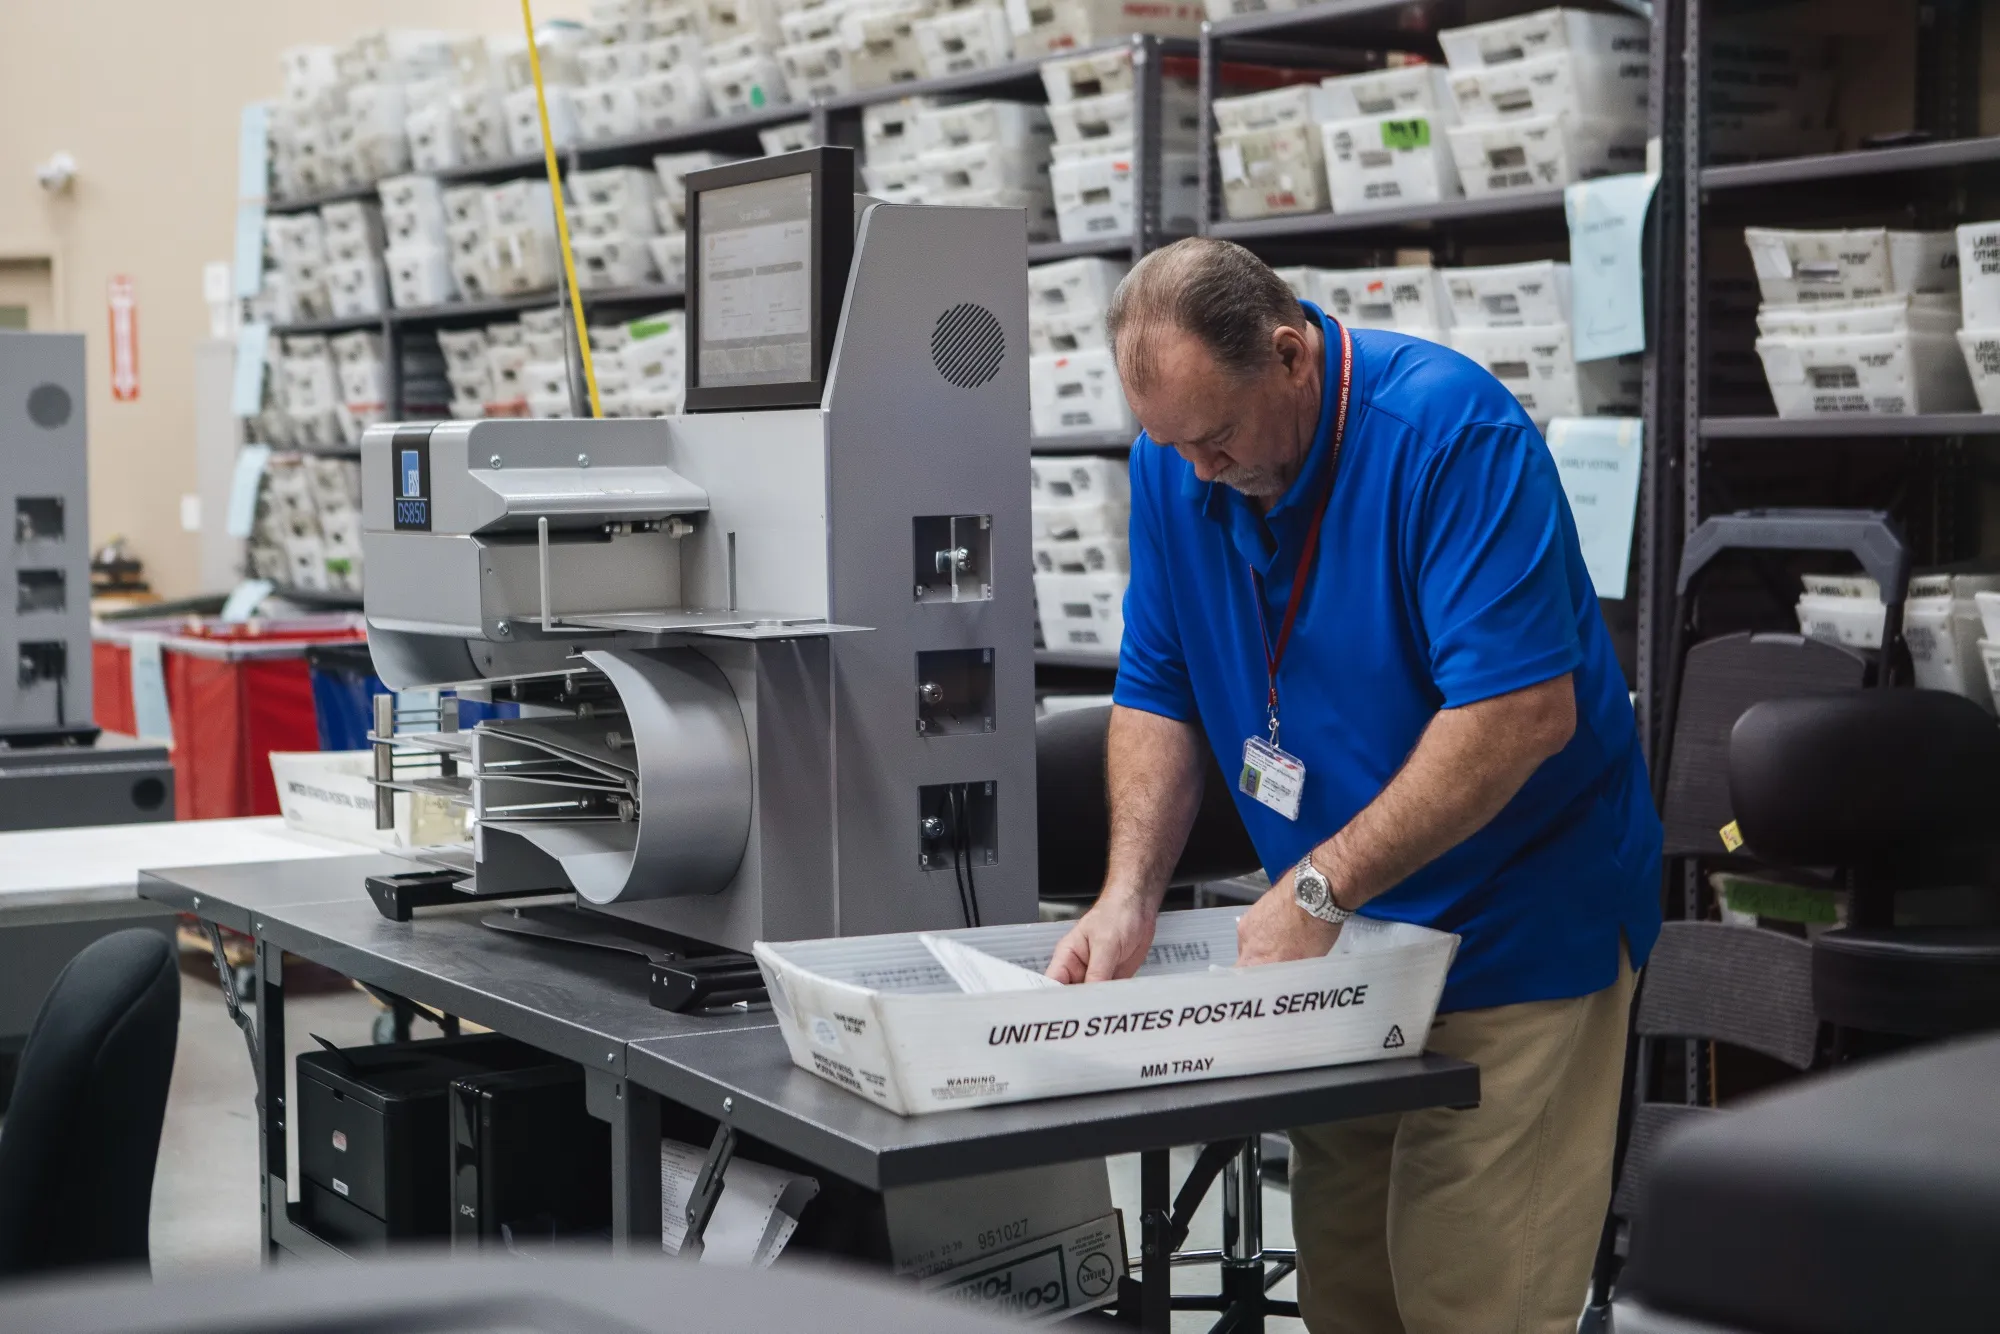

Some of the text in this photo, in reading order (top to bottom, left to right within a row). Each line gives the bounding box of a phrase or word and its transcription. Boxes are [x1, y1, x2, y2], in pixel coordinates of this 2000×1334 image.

[1343, 359, 1351, 386] COUNTY
[1338, 387, 1349, 432] SUPERVISOR
[397, 502, 426, 524] DS850
[988, 984, 1369, 1046] UNITED STATES POSTAL SERVICE
[946, 1074, 996, 1086] WARNING
[1140, 1057, 1214, 1078] MM TRAY
[977, 1218, 1029, 1250] 951027
